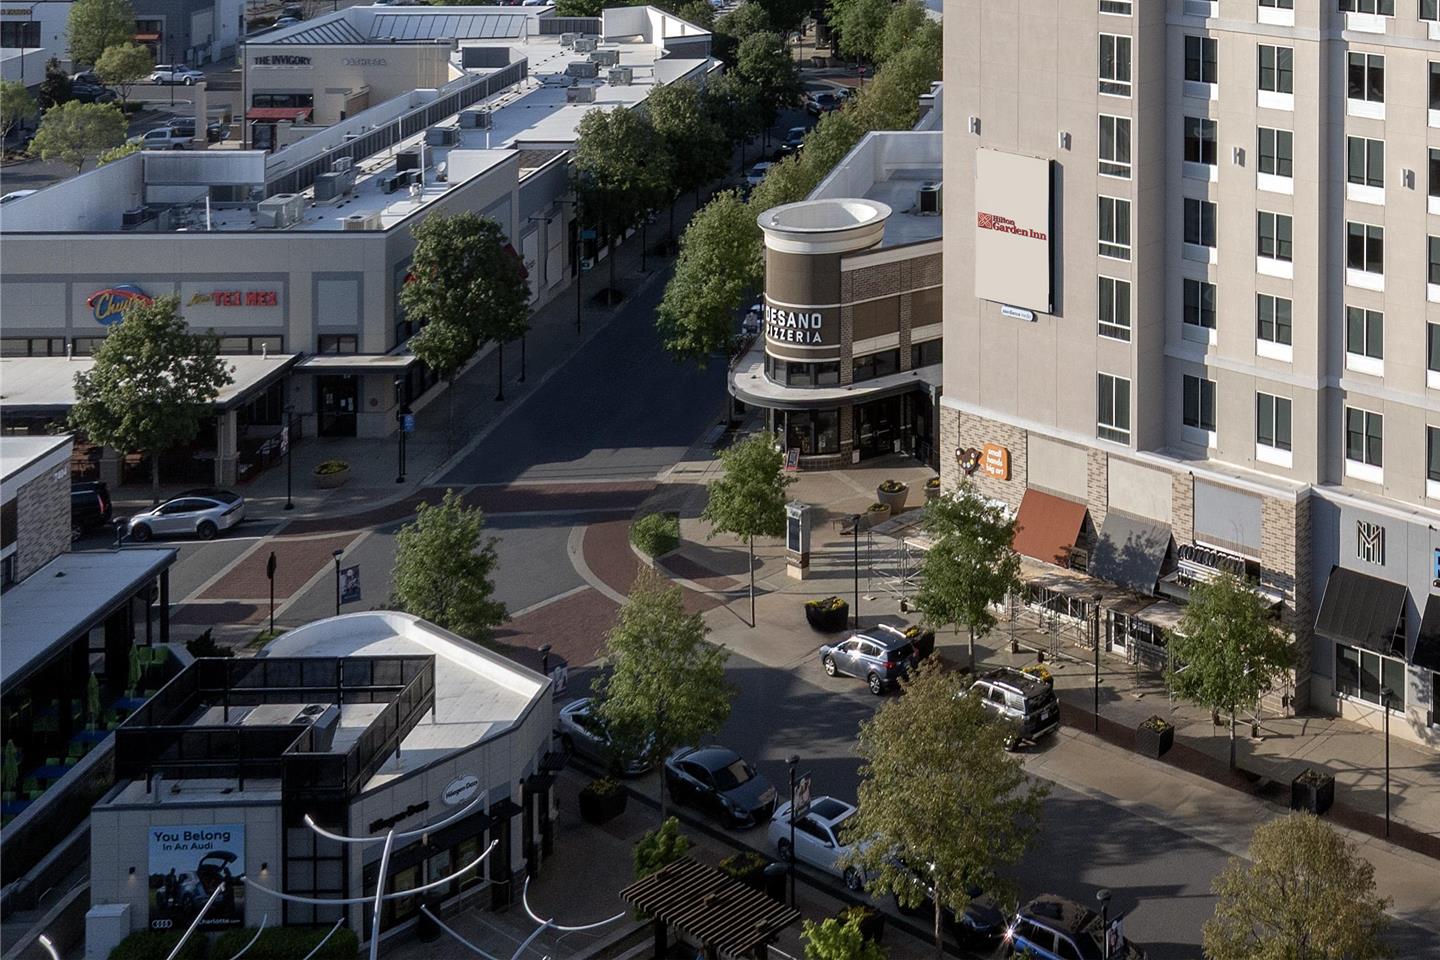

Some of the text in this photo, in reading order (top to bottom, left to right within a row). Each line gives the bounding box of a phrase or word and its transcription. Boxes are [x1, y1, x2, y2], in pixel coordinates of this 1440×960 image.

[254, 55, 312, 65] THE INVIGORY
[992, 215, 1015, 226] Hilton
[992, 221, 1047, 240] Garden Inn
[766, 305, 822, 328] DESANO
[766, 323, 822, 342] PIZZERIA
[154, 830, 231, 842] You Belong
[163, 843, 172, 851] In
[191, 842, 213, 850] Audi
